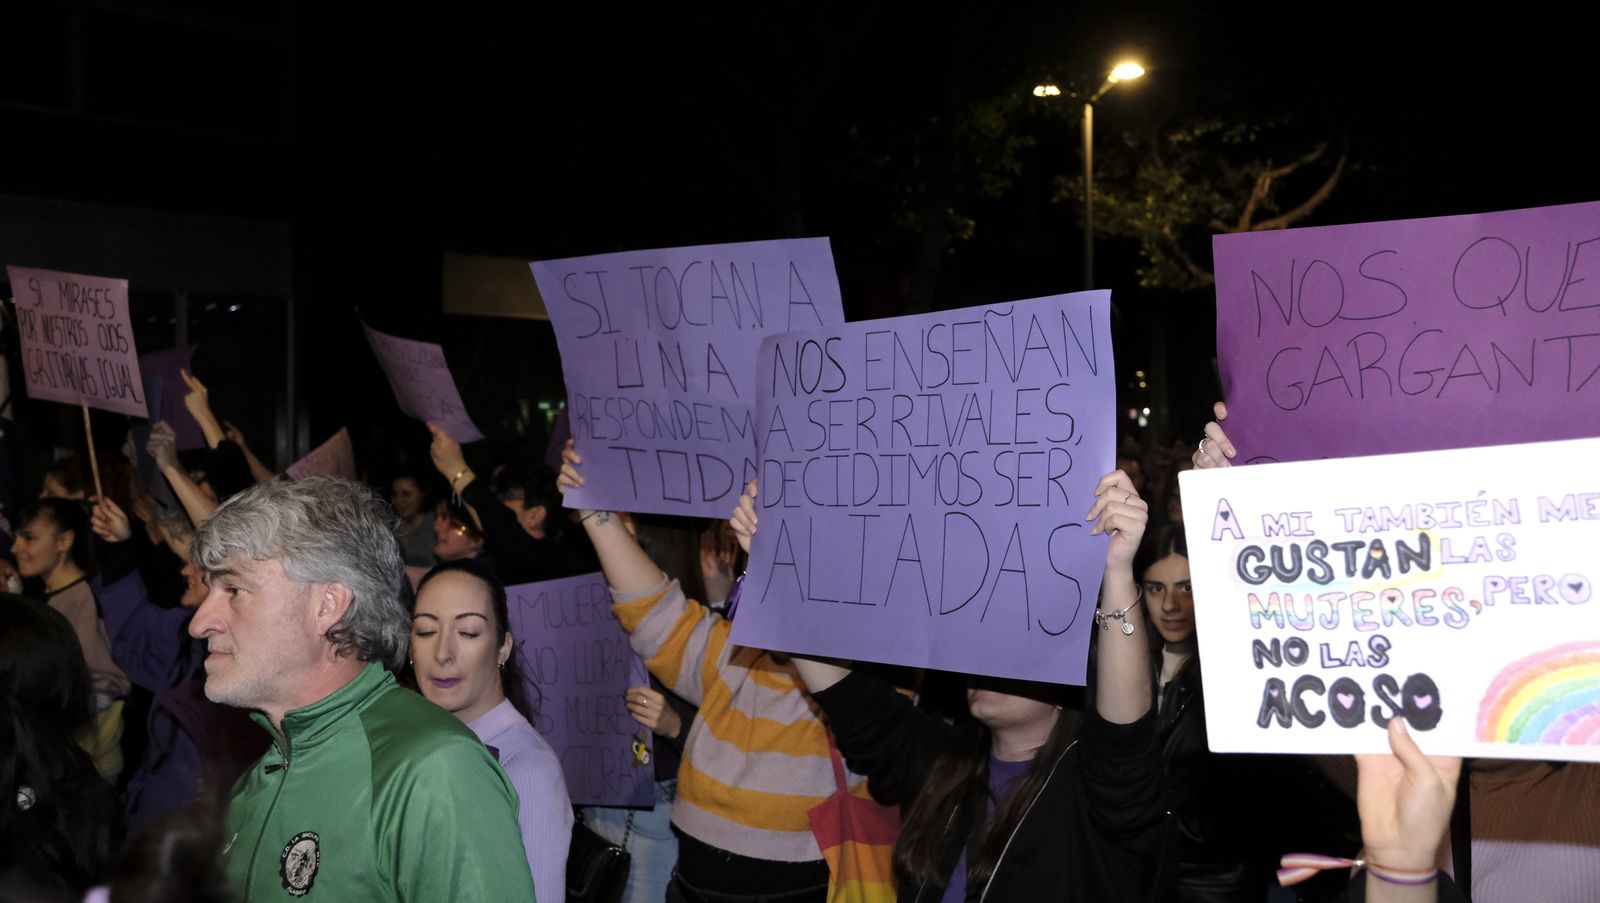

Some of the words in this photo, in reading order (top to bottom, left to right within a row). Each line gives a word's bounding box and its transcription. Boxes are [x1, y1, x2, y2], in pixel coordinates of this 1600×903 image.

[28, 278, 43, 308] SI
[58, 281, 116, 320] MIRASES
[563, 270, 621, 339] SI
[628, 260, 764, 331] TOCAN
[787, 260, 824, 332] A
[1251, 249, 1408, 338] NOS
[18, 307, 38, 343] POR
[97, 323, 129, 354] OJOS
[772, 336, 847, 398] NOS
[865, 305, 1098, 392] ENSEÑAN
[97, 358, 144, 404] IGUAL
[614, 338, 740, 399] UNA
[574, 393, 758, 449] RESPONDEM
[763, 404, 795, 454] A
[805, 396, 879, 452] SER
[892, 383, 1084, 448] RIVALES,
[607, 445, 758, 505] TODA
[762, 450, 984, 508] DECIDIMOS
[993, 447, 1070, 508] SER
[1211, 497, 1245, 541] A
[1261, 511, 1315, 537] MI
[1334, 489, 1522, 534] TAMBIÉN
[1536, 492, 1600, 524] ME
[760, 511, 1083, 636] ALIADAS
[1236, 532, 1432, 585] GUSTAN
[1439, 532, 1517, 565] LAS
[516, 583, 619, 633] MUJERE
[1246, 586, 1483, 632] MUJERES,
[1482, 573, 1592, 607] PERO
[519, 642, 559, 686] NO
[1252, 636, 1310, 669] NO
[1319, 634, 1392, 669] LAS
[1256, 672, 1443, 731] ACOSO
